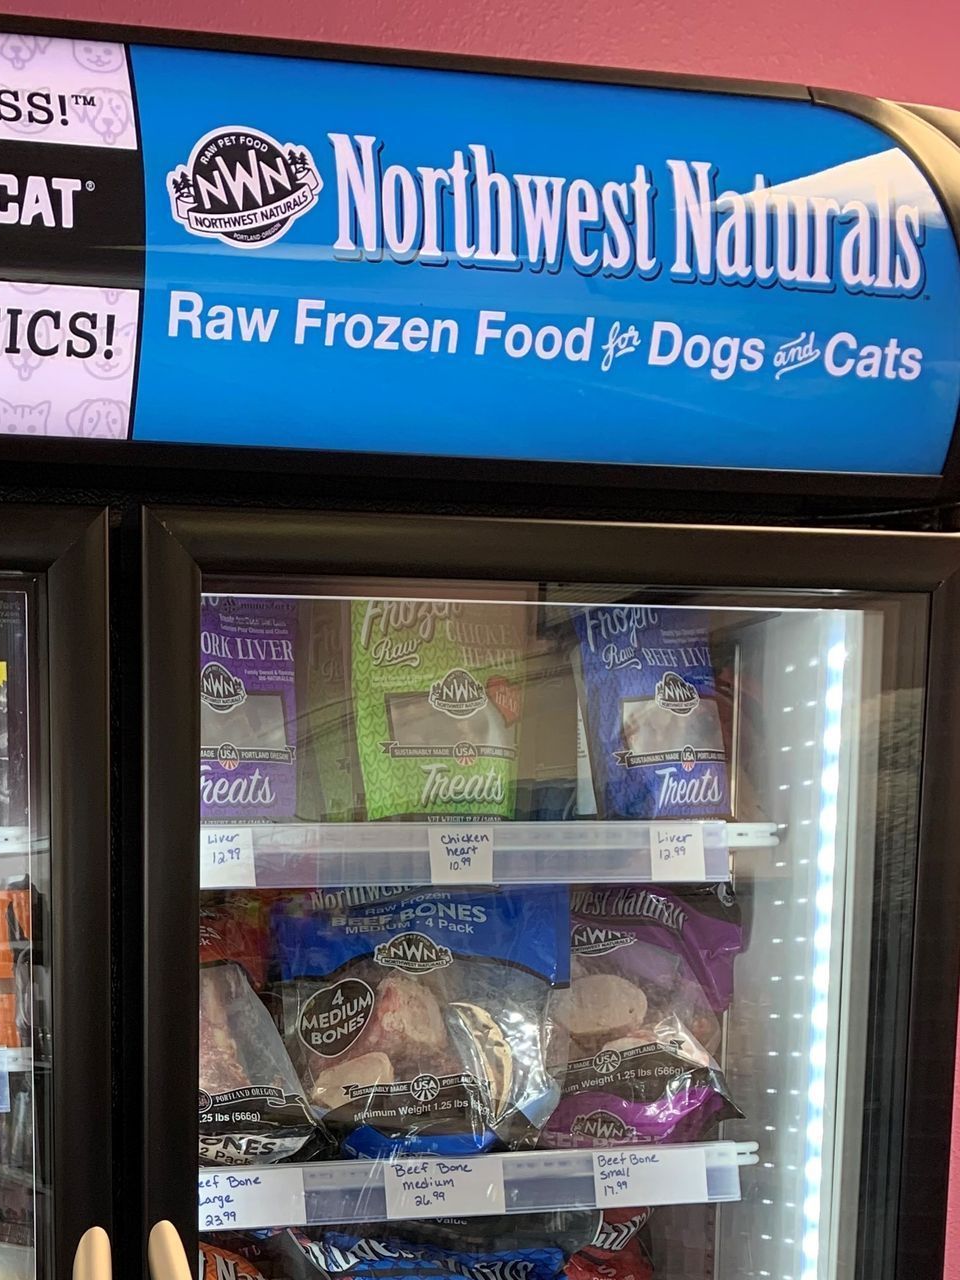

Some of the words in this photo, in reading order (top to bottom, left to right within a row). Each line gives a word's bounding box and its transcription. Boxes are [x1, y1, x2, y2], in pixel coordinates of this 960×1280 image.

[200, 144, 218, 165] RAW
[218, 136, 237, 148] PET
[240, 136, 269, 153] FOOD
[196, 149, 291, 211] NWN
[194, 215, 258, 229] NORTHWEST
[261, 191, 308, 222] NATURALS
[327, 132, 658, 275] Northwest
[666, 158, 927, 292] Naturals
[167, 291, 280, 344] Raw
[294, 298, 459, 355] Frozen
[475, 310, 595, 363] Food
[602, 320, 642, 372] for
[648, 321, 764, 381] Dogs
[773, 331, 821, 380] and
[824, 331, 923, 381] Cats
[236, 638, 294, 662] LIVER
[415, 763, 505, 808] Treats
[208, 833, 240, 845] Liver
[440, 833, 490, 845] Chicken
[657, 832, 693, 844] Liver
[445, 845, 478, 857] heart
[659, 846, 686, 860] 12.99
[300, 990, 373, 1031] MEDIUM
[311, 1013, 365, 1046] BONES
[391, 1162, 429, 1177] Beef
[436, 1162, 473, 1174] Bone
[597, 1153, 627, 1167] Beef
[630, 1154, 660, 1165] Bone
[226, 1175, 262, 1188] Bone
